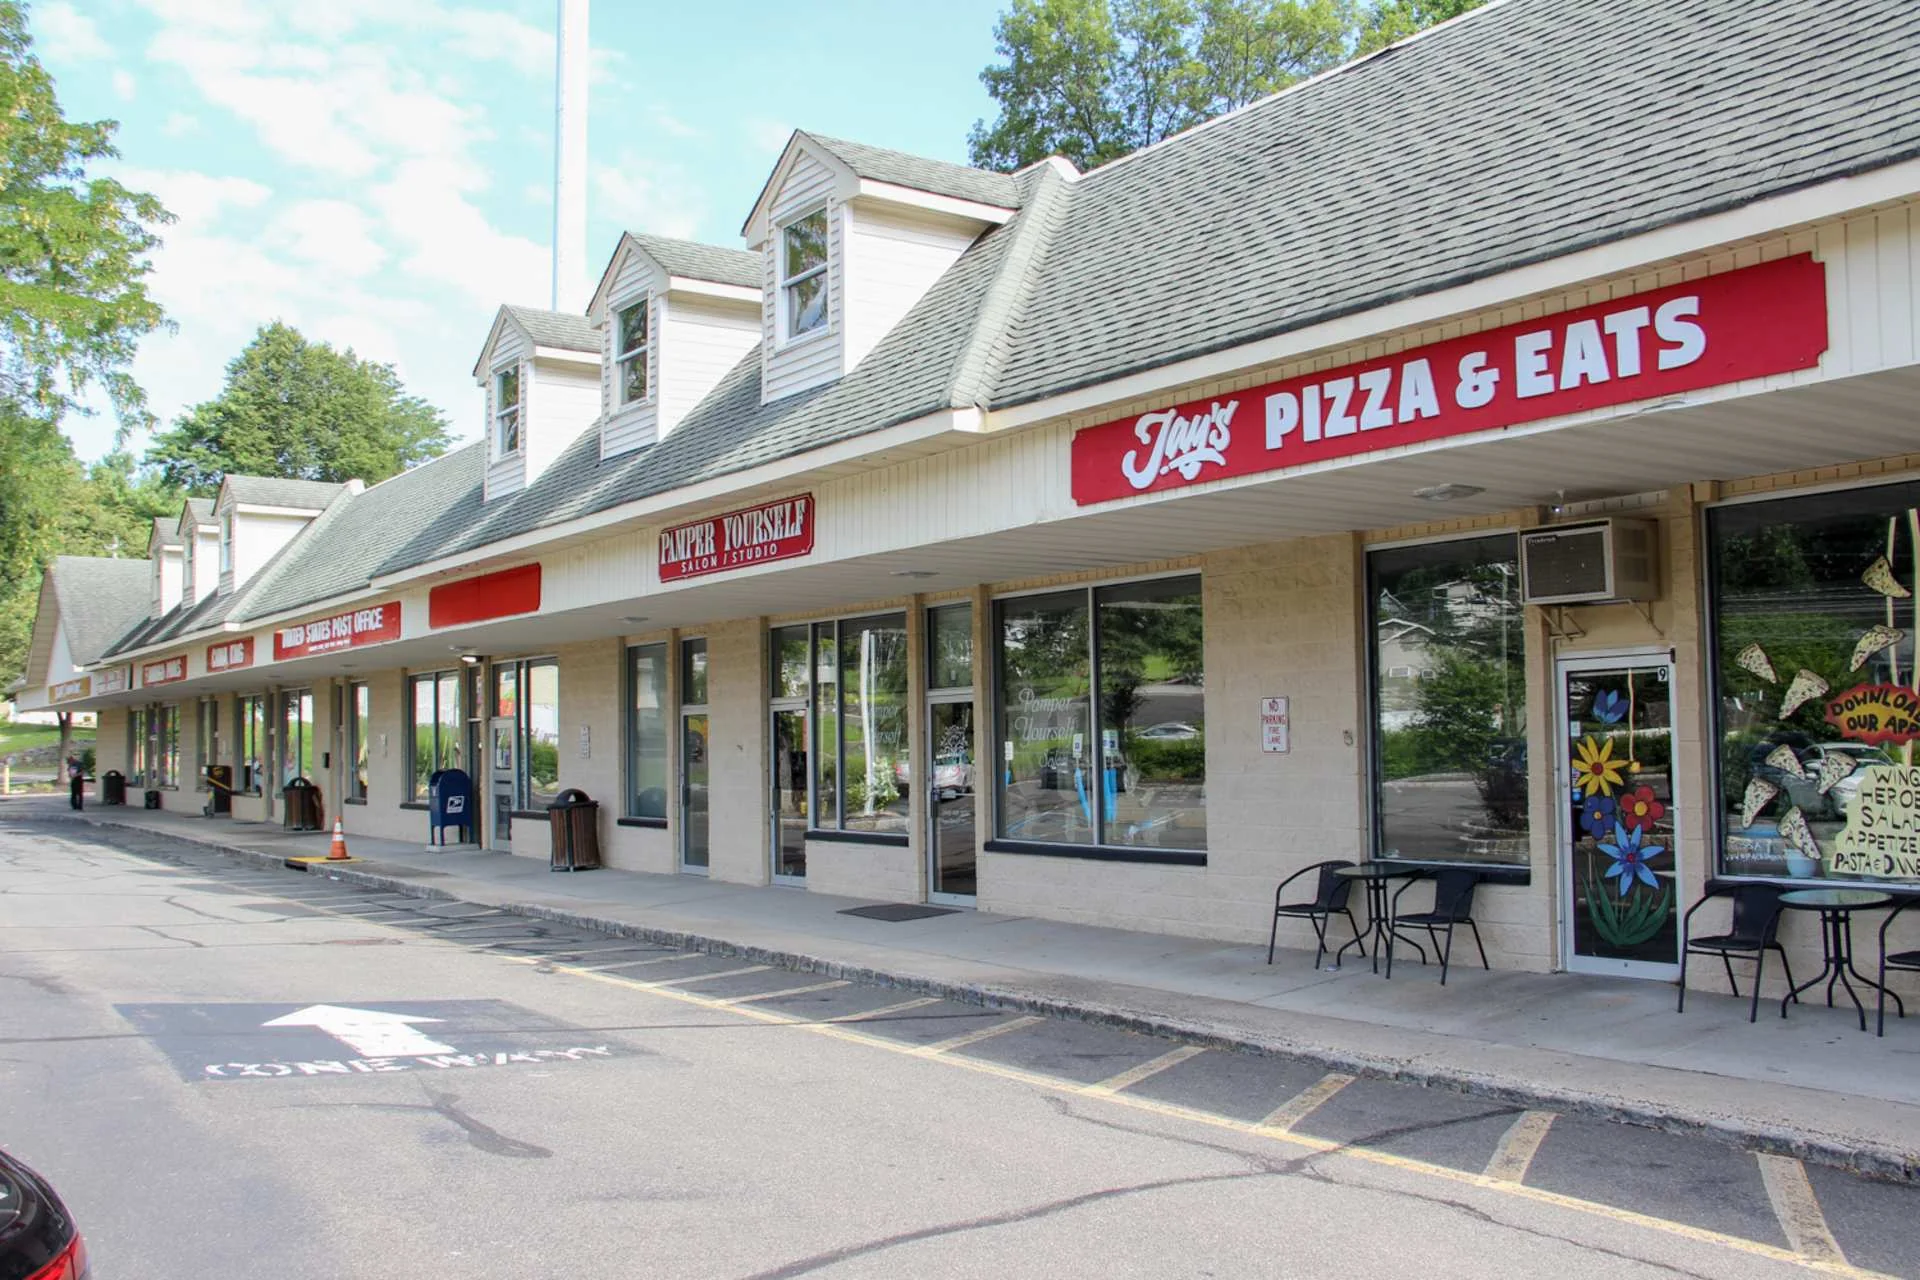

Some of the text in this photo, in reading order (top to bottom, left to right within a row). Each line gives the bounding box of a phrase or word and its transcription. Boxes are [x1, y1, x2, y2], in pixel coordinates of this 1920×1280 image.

[1121, 296, 1707, 489] Jay's PIZZA & EATS
[660, 499, 806, 565] PAMPER YOURSELF
[681, 555, 718, 574] SALON
[732, 543, 778, 564] STUDIO
[306, 620, 331, 643] STATES
[332, 615, 352, 638] POST
[354, 607, 384, 633] OFFICE
[1659, 667, 1666, 681] 9
[1846, 713, 1879, 732] OUR
[1835, 852, 1872, 873] PASTA
